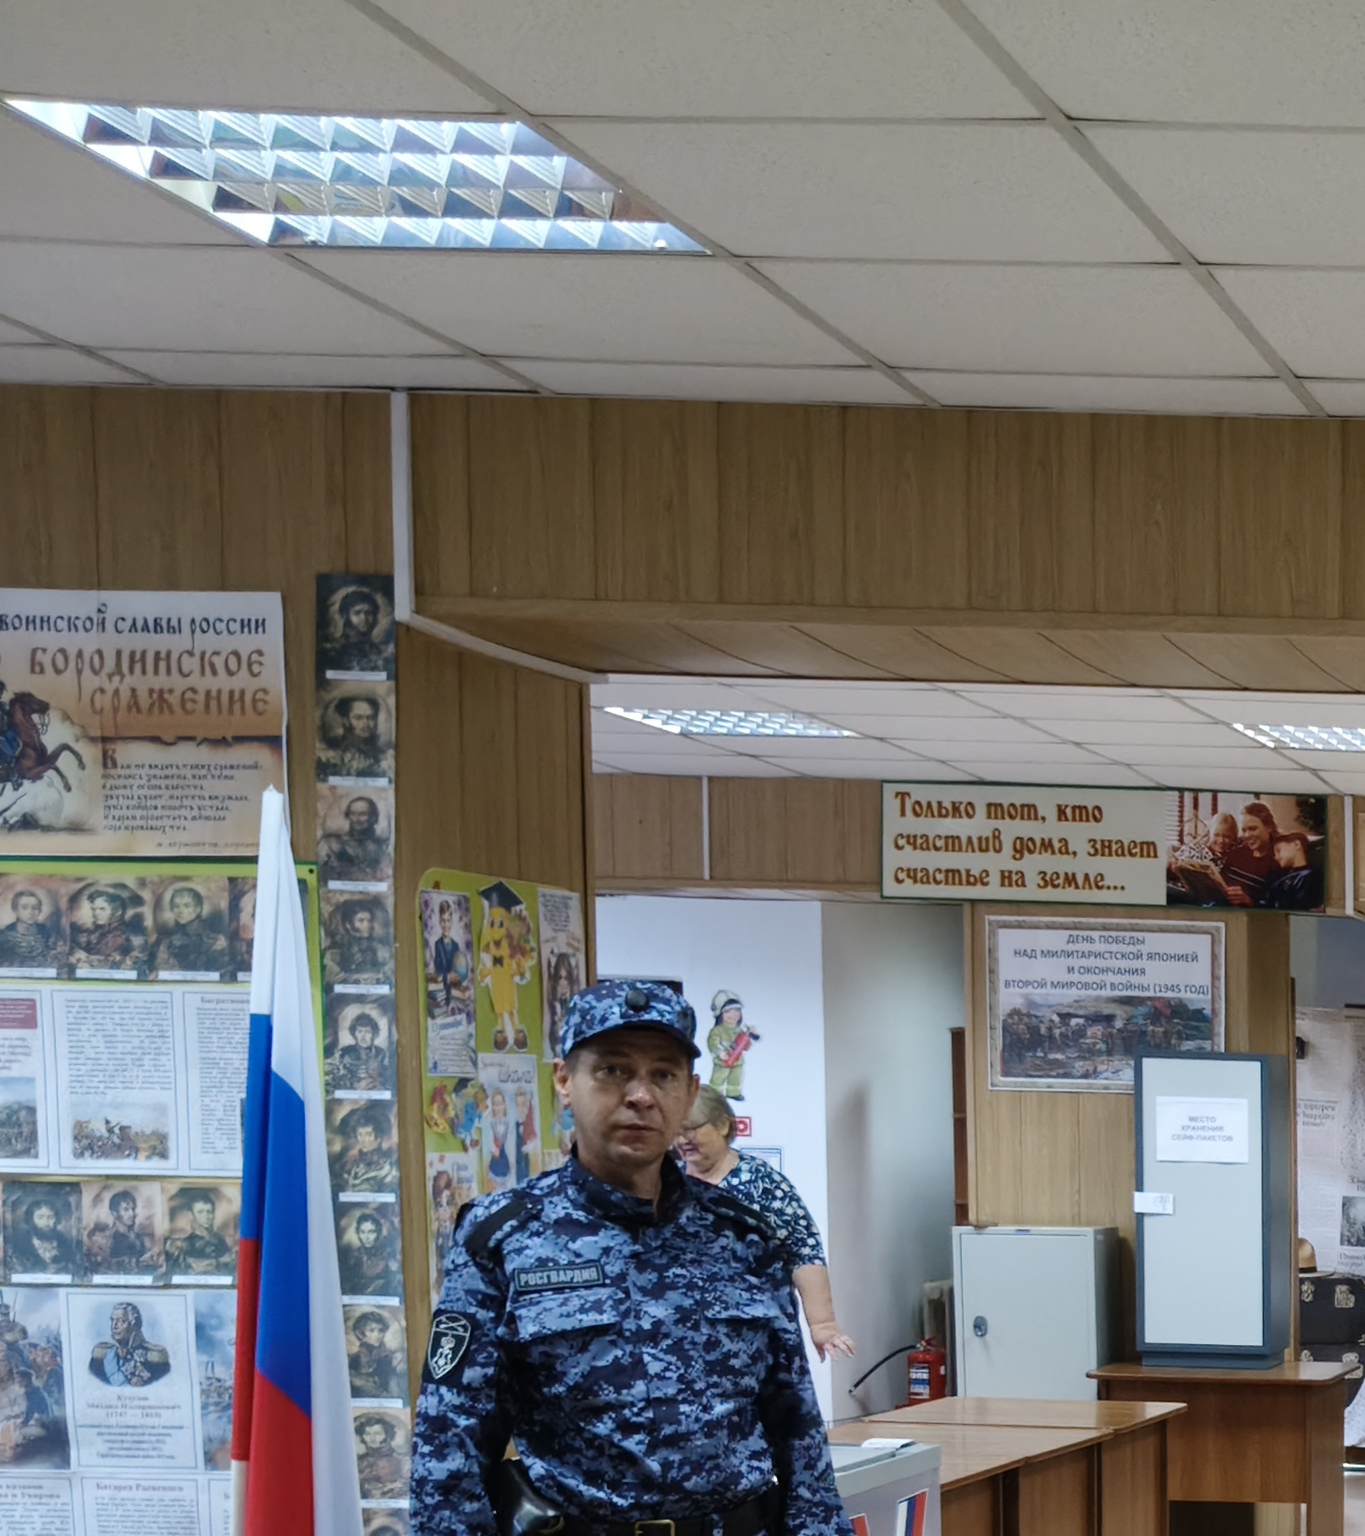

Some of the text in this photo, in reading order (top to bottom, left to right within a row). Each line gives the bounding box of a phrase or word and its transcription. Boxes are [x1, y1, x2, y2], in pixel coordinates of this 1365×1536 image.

[895, 791, 1103, 824] Только тот, кто
[894, 828, 1159, 861] счастлив дома, знает
[894, 866, 1126, 892] счастье на земле...
[1066, 933, 1146, 946] ДЕНЬ ПОБЕДЫ
[1014, 948, 1199, 963] НАД МИЛИТАРИСТСКОЙ ЯПОНИЕЙ
[1067, 965, 1146, 977] И ОКОНЧАНИЯ
[1004, 977, 1048, 990] ВТОРОЙ
[1050, 978, 1108, 992] МИРОВОЙ
[1110, 979, 1151, 993] ВОЙНЫ
[1185, 983, 1210, 996] ГОД)
[520, 1267, 599, 1286] РОСГВАРДИЯ
